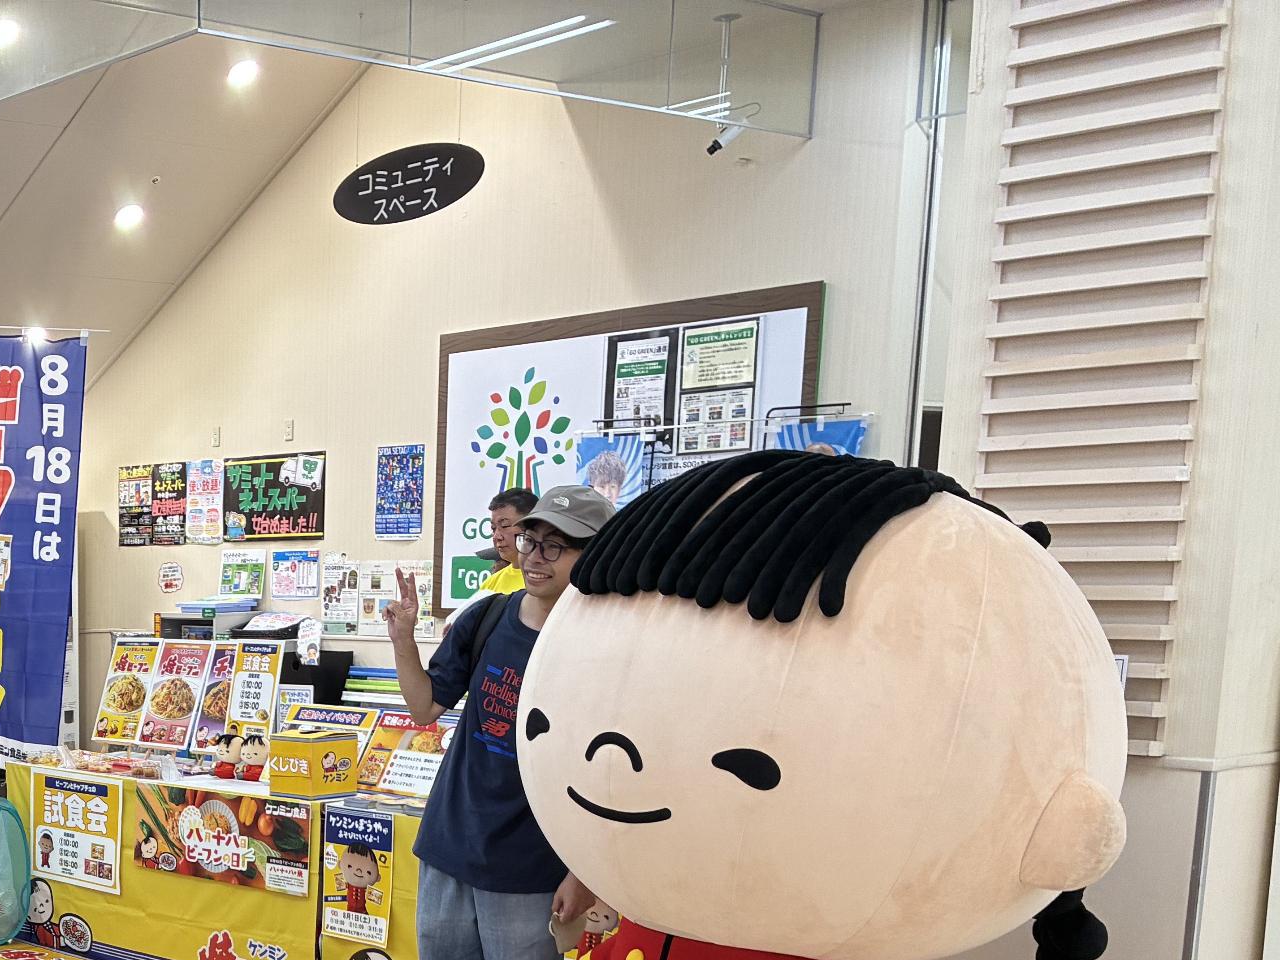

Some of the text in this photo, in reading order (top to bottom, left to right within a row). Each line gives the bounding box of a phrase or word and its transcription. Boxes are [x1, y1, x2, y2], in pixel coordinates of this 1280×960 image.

[358, 158, 454, 195] コミュニティ
[373, 187, 438, 221] スペース
[26, 354, 71, 561] 8月18日は
[226, 462, 274, 490] サミット
[238, 486, 307, 513] ネットスーパー
[251, 512, 317, 534] 始めました!!
[242, 655, 272, 672] 試食会
[502, 666, 523, 688] The
[483, 696, 518, 721] Choice
[270, 756, 309, 775] くじびき
[321, 772, 350, 784] ケンミン
[43, 789, 109, 835] 試食会
[264, 802, 308, 820] ケンミン食品
[185, 827, 248, 849] 八月十八日
[186, 844, 241, 869] ビーフンの日
